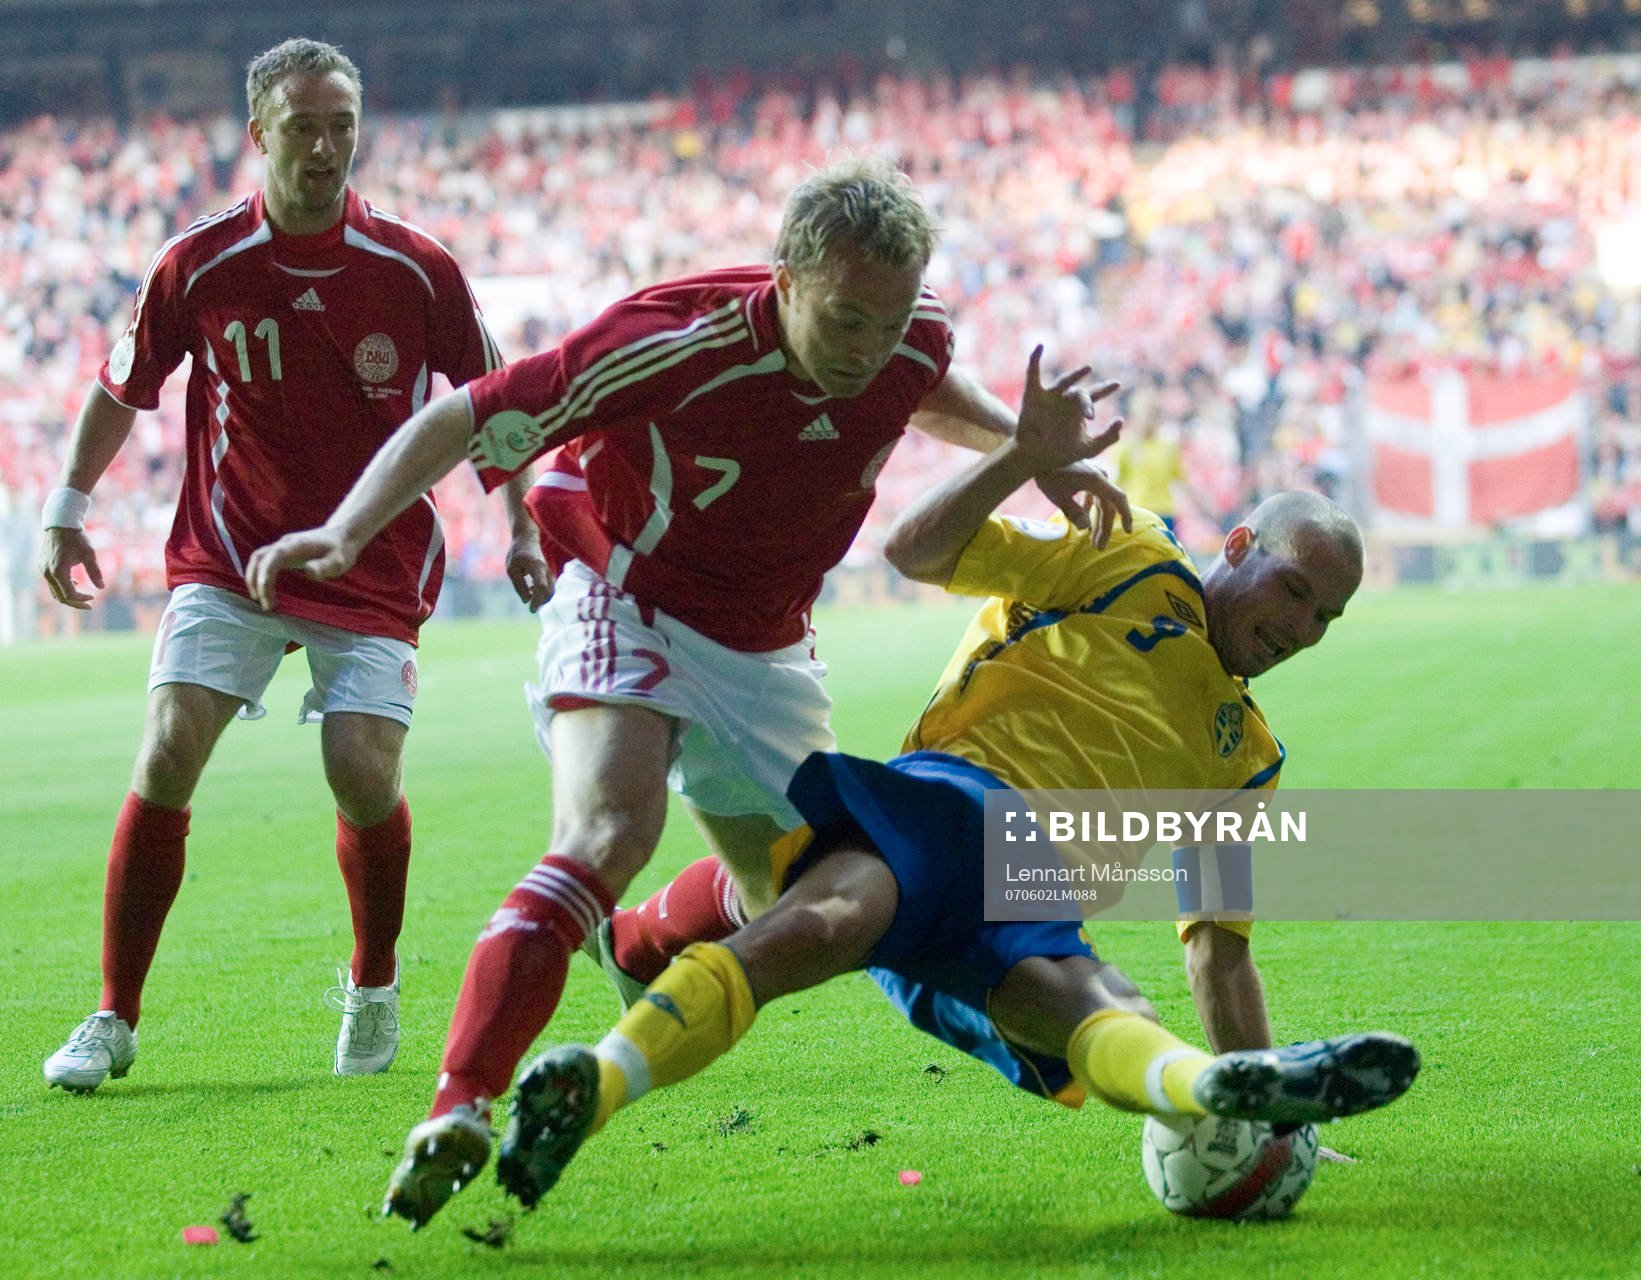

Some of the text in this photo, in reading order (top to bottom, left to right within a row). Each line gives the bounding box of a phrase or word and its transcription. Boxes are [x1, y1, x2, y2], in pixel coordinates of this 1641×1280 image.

[292, 302, 326, 312] adidas
[223, 318, 282, 382] 11
[798, 430, 840, 440] adidas
[692, 455, 741, 511] 7
